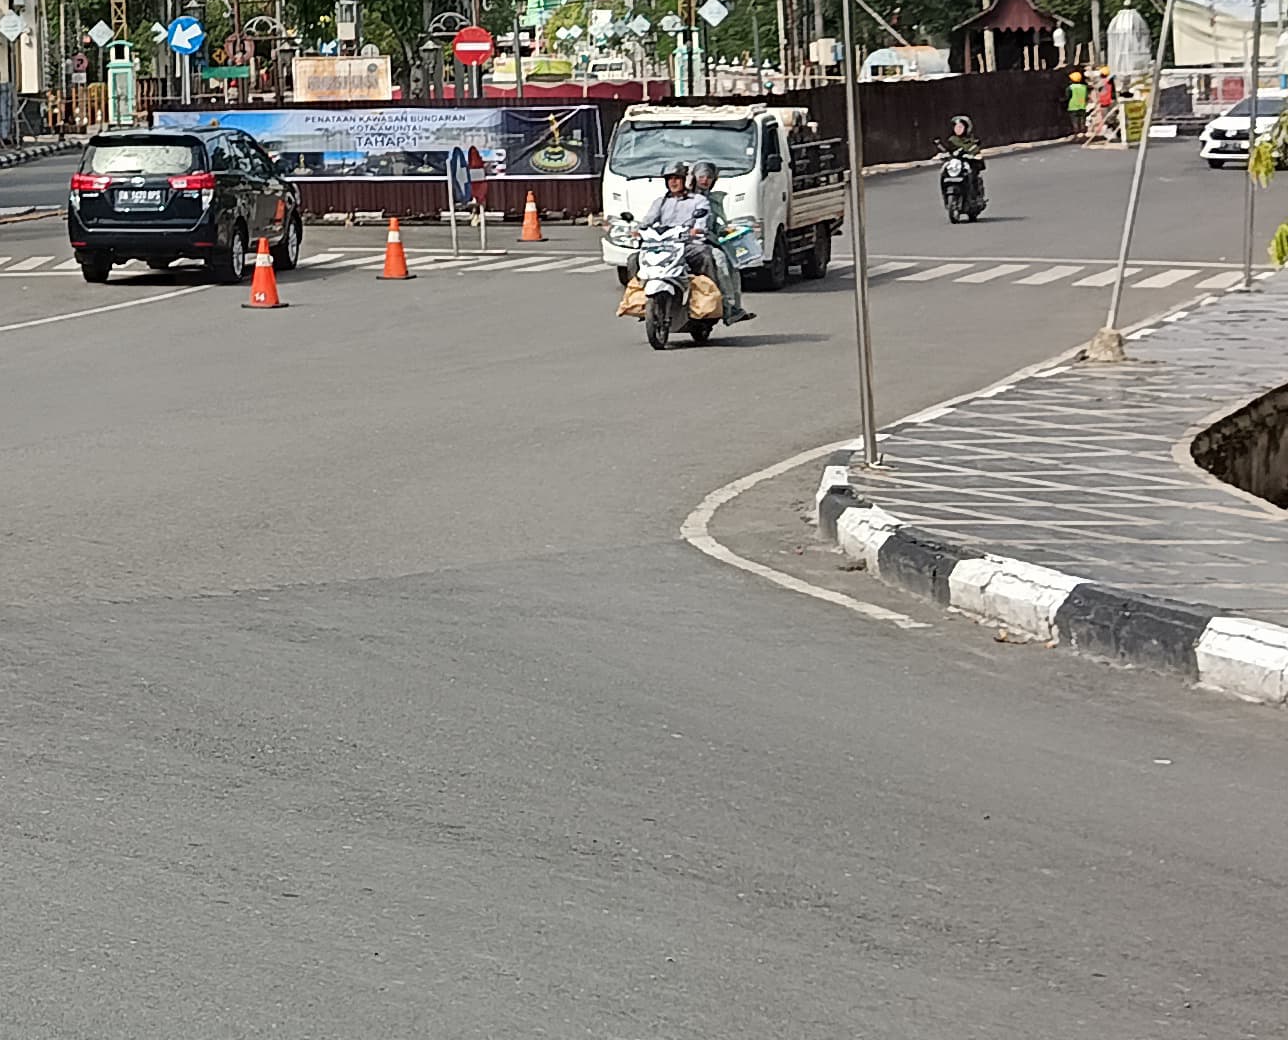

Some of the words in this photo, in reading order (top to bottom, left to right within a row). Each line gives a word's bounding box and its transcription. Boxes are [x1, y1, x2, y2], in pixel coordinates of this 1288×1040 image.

[358, 115, 408, 123] KAWASAN
[410, 115, 466, 123] BUNDARAN
[349, 125, 375, 133] KOTA
[378, 124, 421, 132] AMUNTAI
[356, 136, 406, 147] TAHAP
